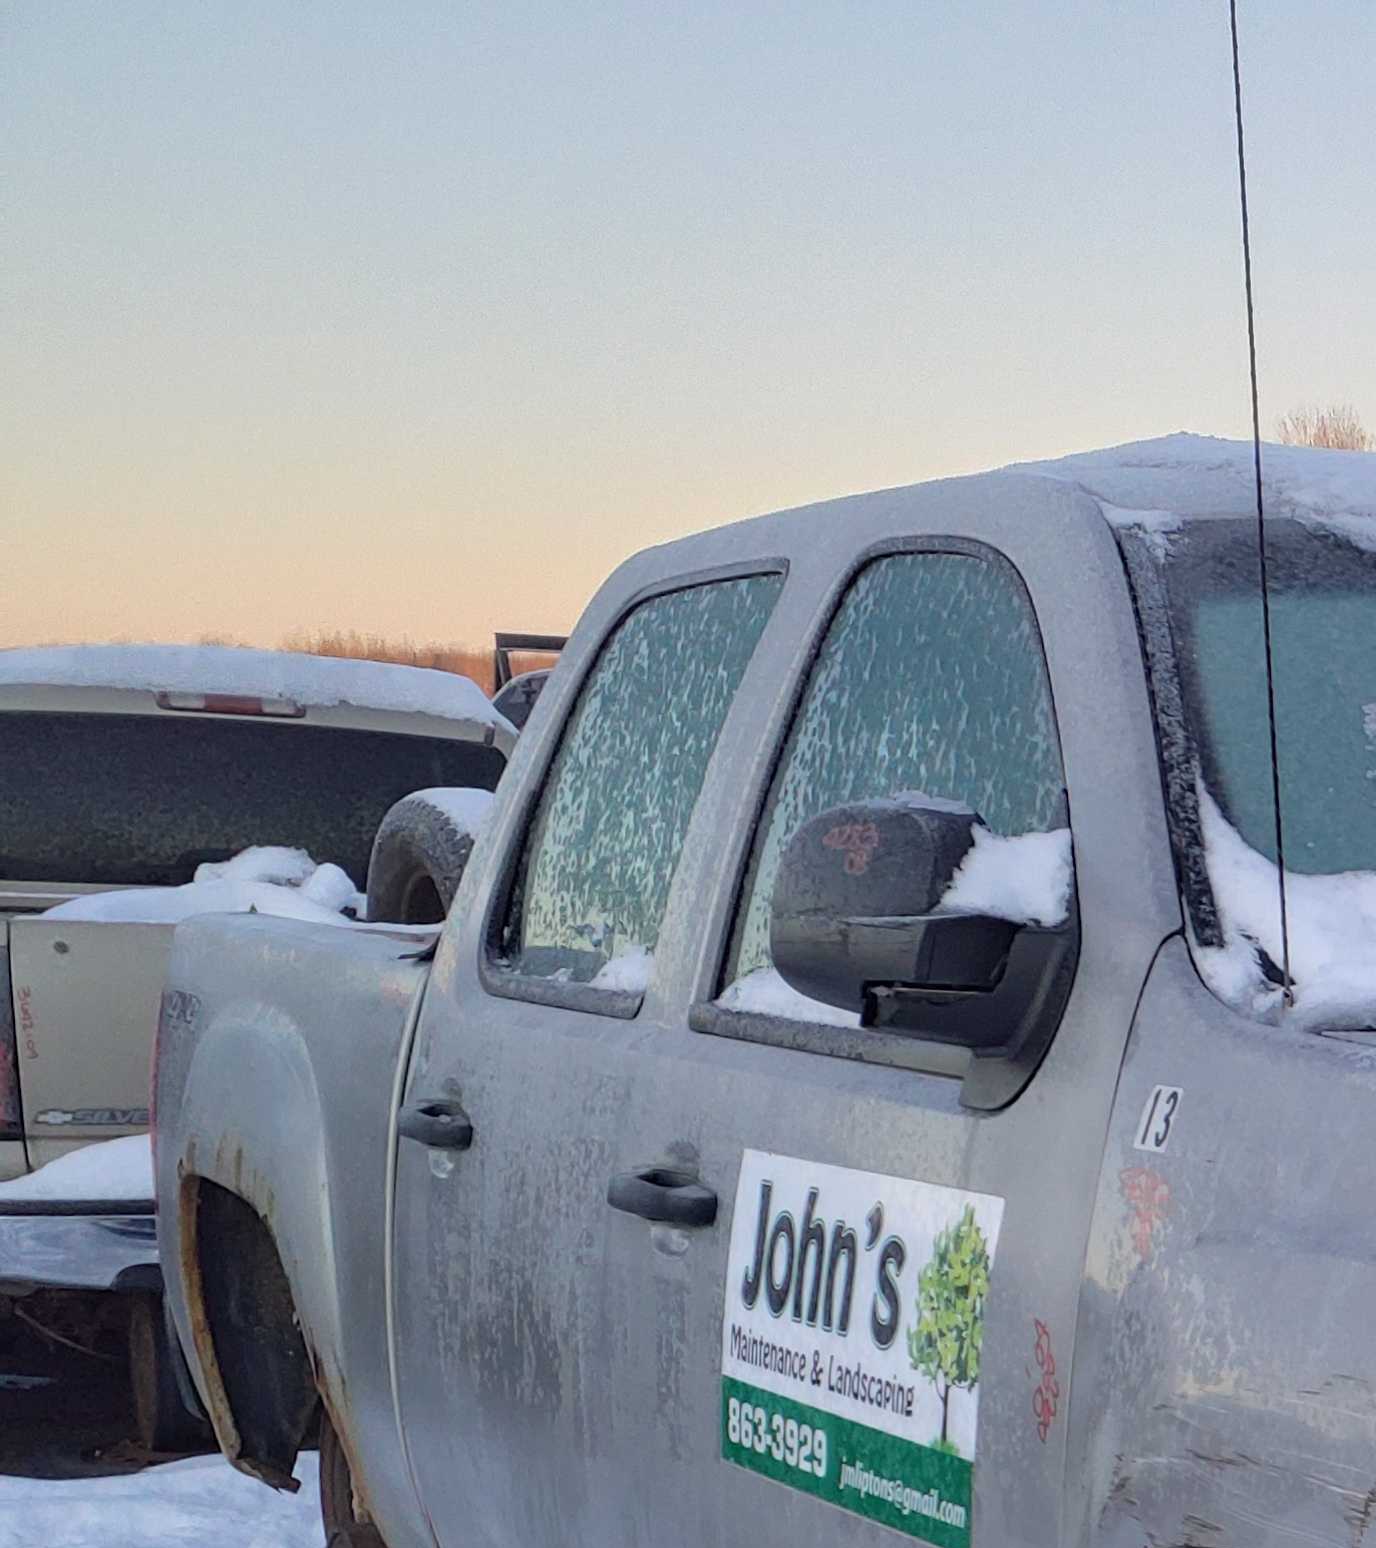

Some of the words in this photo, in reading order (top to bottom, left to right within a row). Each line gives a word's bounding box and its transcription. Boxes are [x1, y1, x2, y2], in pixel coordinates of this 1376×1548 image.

[1139, 1088, 1180, 1148] 13
[741, 1178, 907, 1352] John's
[730, 1323, 806, 1381] Maintenance
[810, 1349, 824, 1387] &
[828, 1354, 915, 1417] Landscaping
[728, 1397, 828, 1478] 863-3929
[838, 1456, 966, 1529] jmliptons@gmail.com
